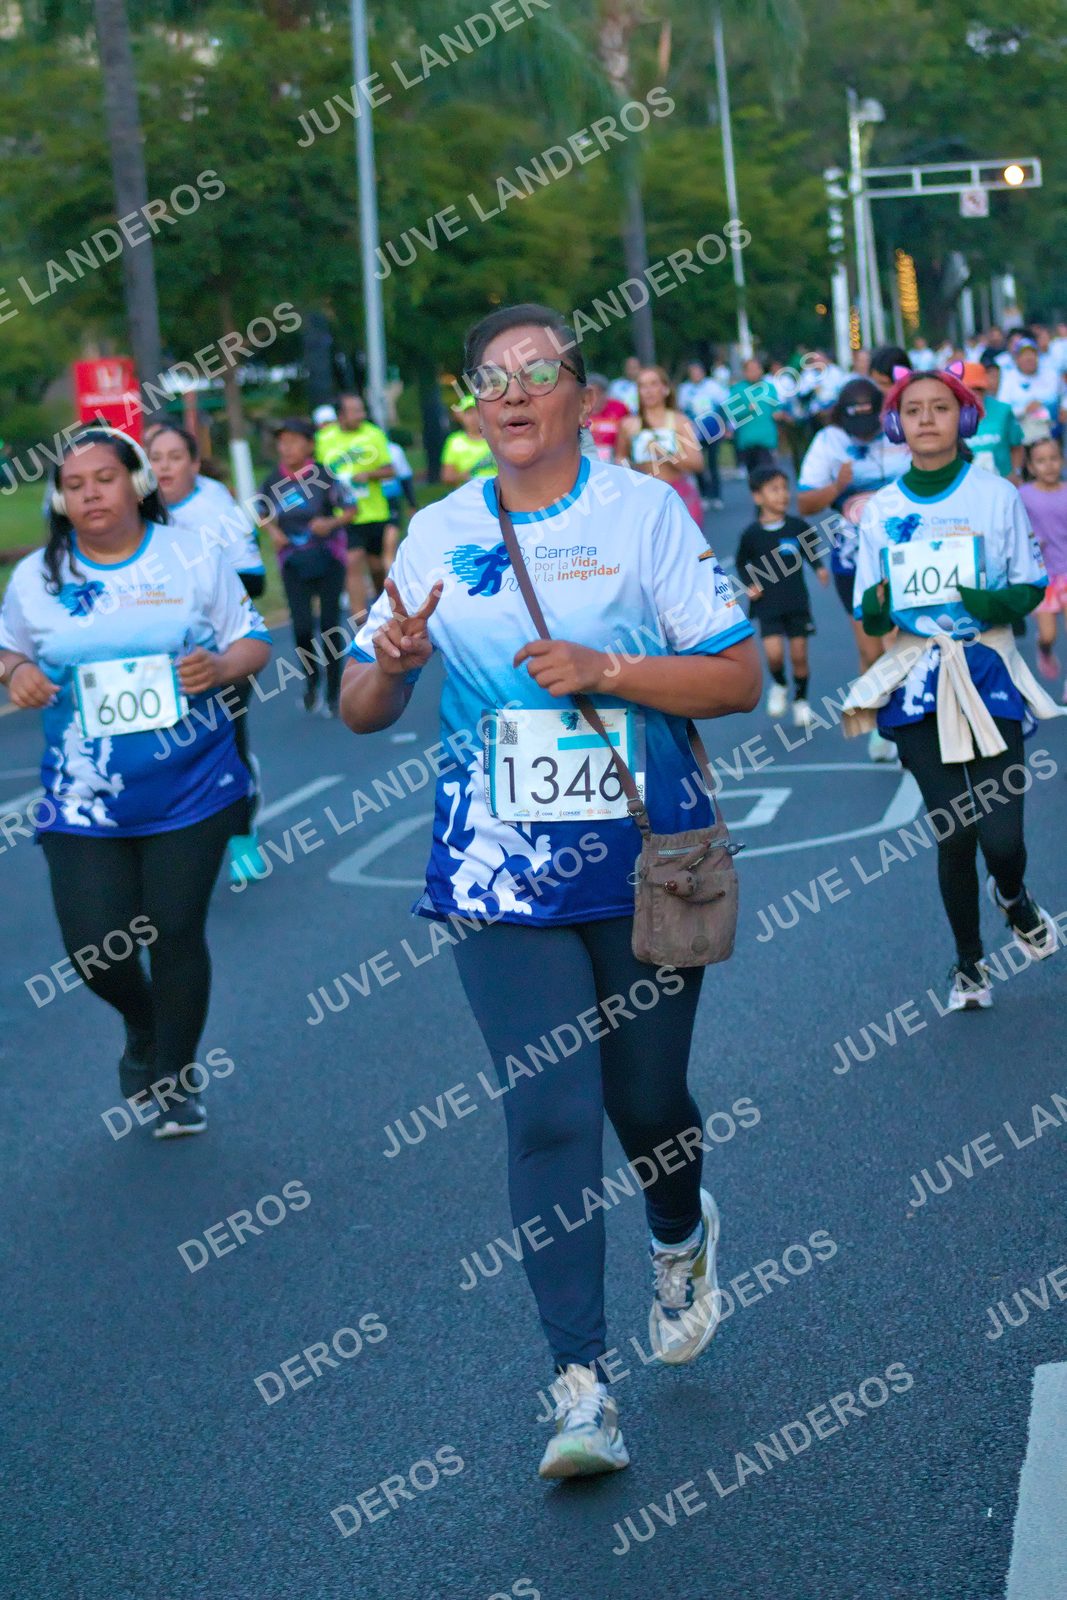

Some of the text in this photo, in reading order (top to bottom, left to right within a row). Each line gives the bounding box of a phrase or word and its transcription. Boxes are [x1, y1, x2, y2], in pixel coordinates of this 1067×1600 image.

[535, 545, 597, 559] Carrera
[535, 556, 597, 571] por la Vida
[534, 564, 621, 584] y la Integridad
[903, 565, 960, 596] 404
[98, 688, 161, 725] 600
[502, 754, 624, 805] 1346
